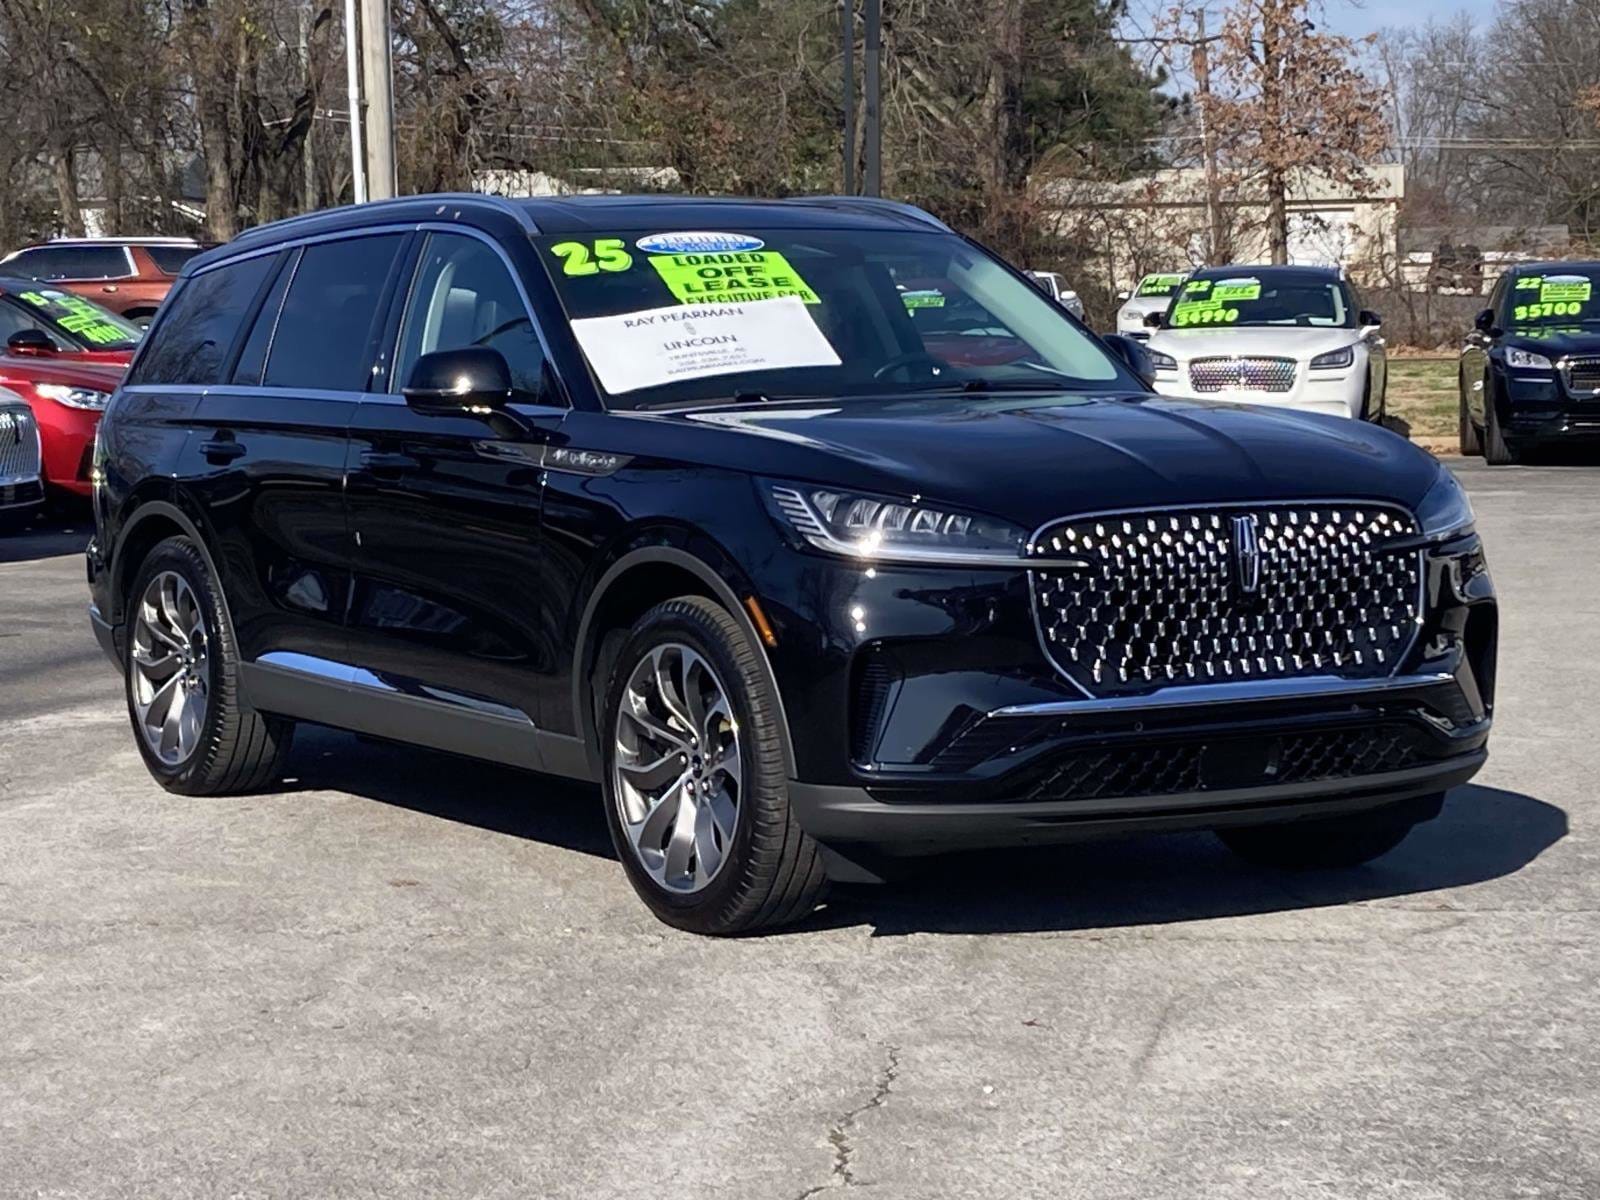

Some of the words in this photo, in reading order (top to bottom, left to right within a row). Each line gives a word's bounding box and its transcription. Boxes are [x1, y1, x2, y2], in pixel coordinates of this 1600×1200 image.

[550, 239, 632, 276] 25
[672, 253, 765, 267] LOADED
[697, 266, 764, 279] OFF
[683, 277, 791, 294] LEASE
[1515, 277, 1542, 289] 22
[686, 292, 769, 304] EXECUTIVE
[624, 316, 656, 328] RAY
[661, 307, 744, 324] PEARMAN
[664, 335, 738, 351] LINCOLN
